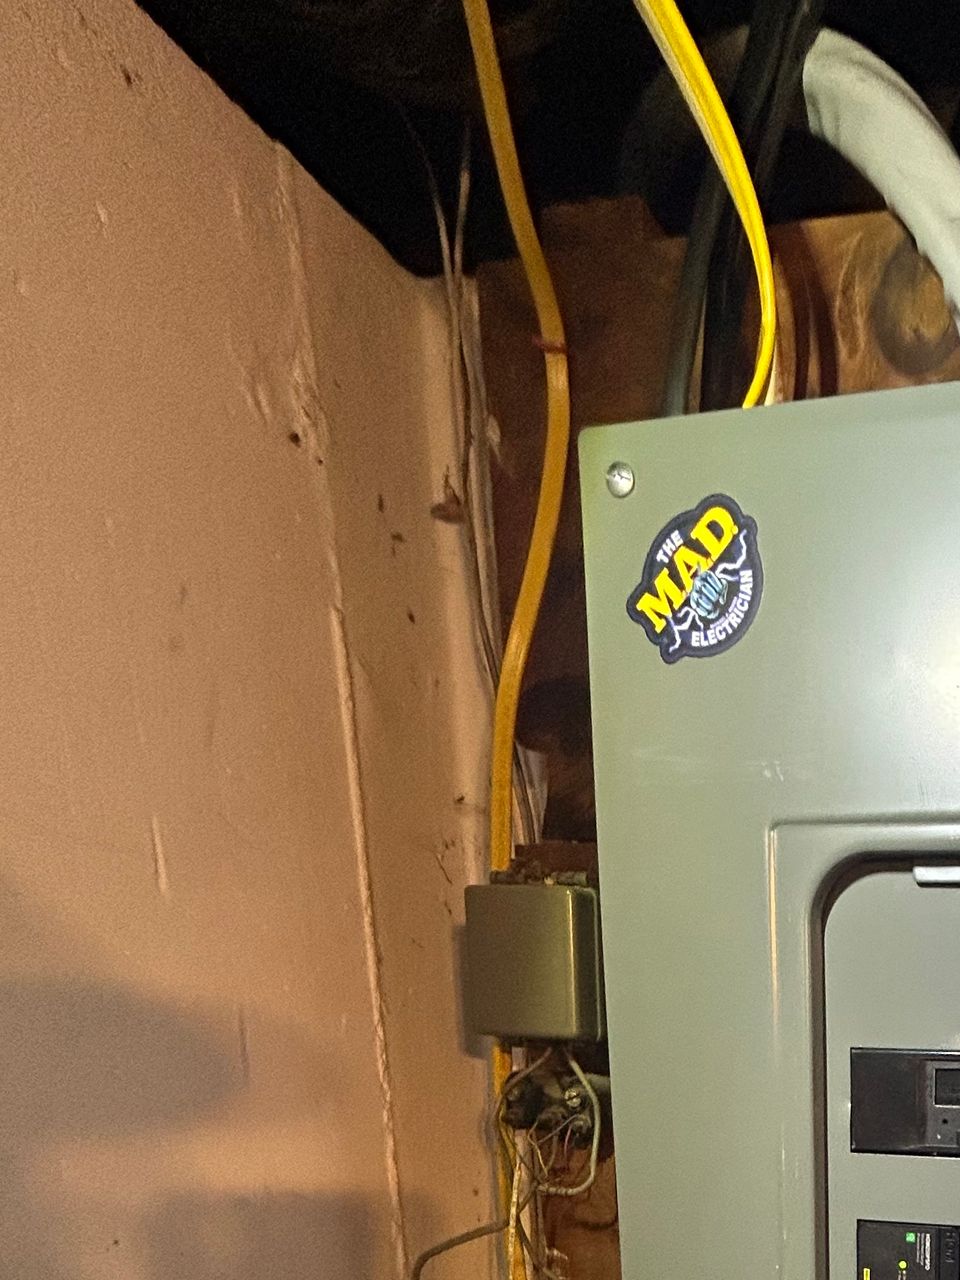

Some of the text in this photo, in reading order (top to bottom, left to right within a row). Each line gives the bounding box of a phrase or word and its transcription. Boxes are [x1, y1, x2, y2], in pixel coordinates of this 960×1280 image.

[636, 507, 738, 633] MAD
[656, 530, 684, 563] THE
[691, 569, 753, 647] ELECTRICIAN
